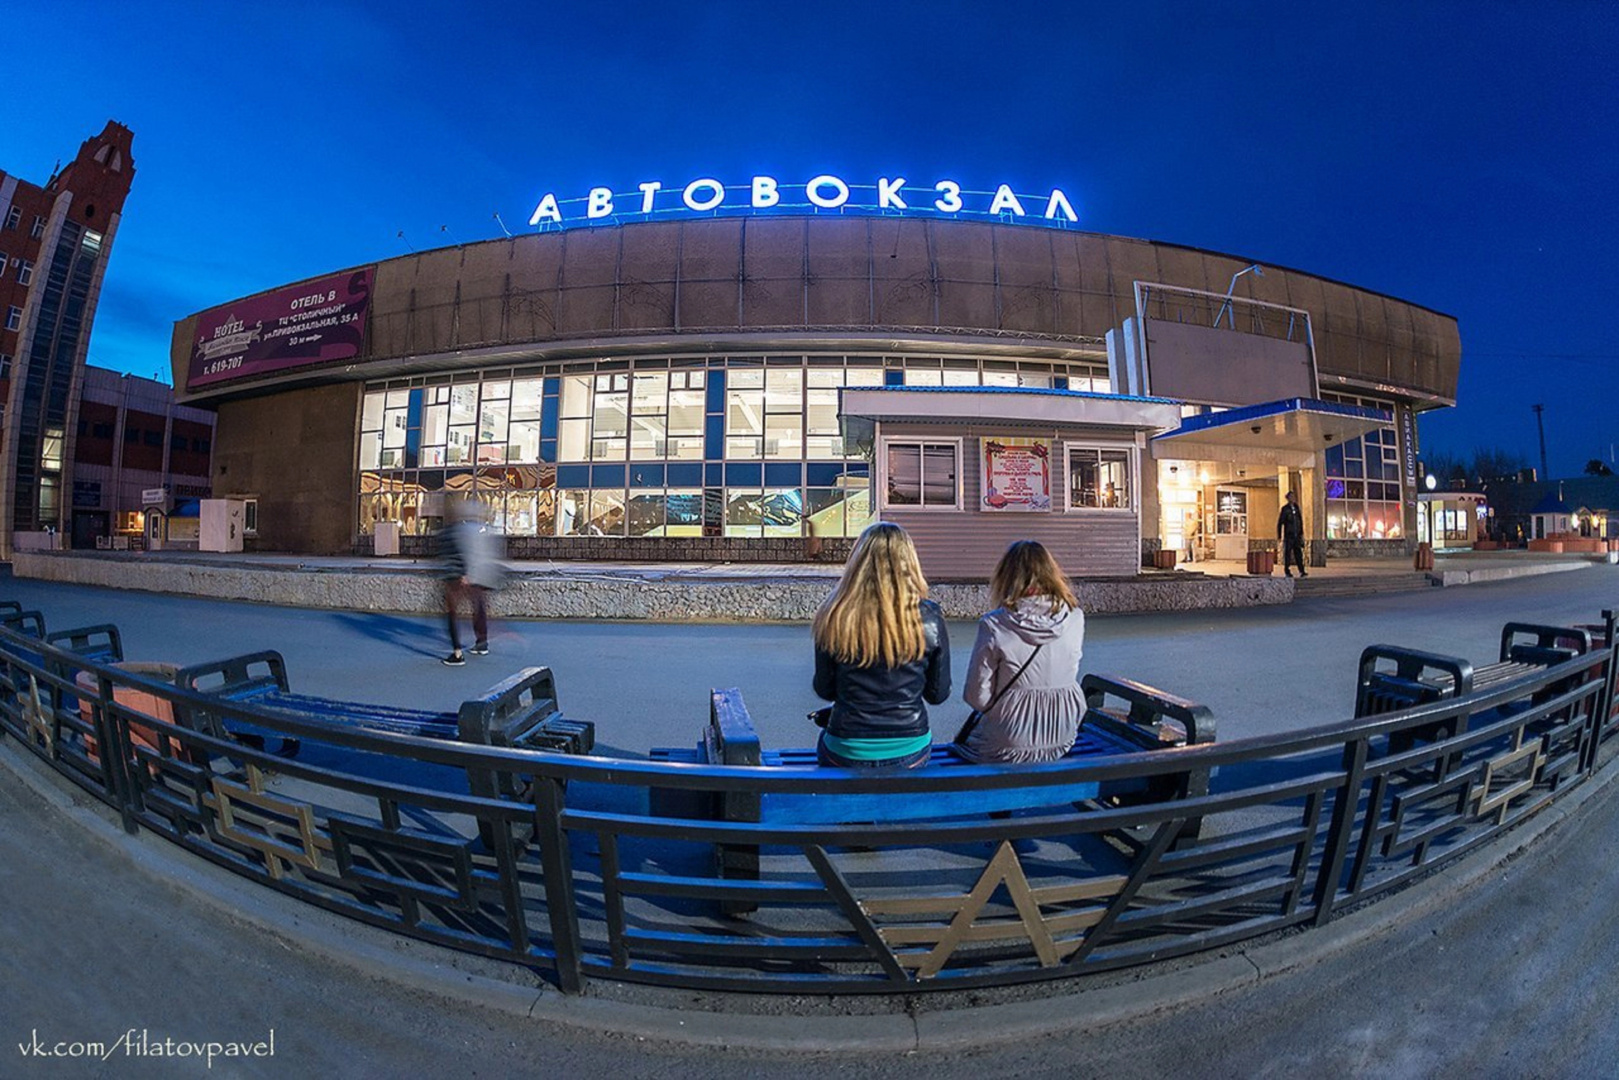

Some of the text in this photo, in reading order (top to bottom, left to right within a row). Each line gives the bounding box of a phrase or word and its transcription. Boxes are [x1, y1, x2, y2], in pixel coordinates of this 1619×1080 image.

[529, 175, 1078, 225] АВТОВОКЗАЛ
[290, 290, 336, 310] ОТЕЛЬ В
[213, 320, 245, 339] HOTEL
[278, 315, 289, 326] ТЦ
[289, 337, 298, 346] 30
[210, 356, 244, 374] 619-707
